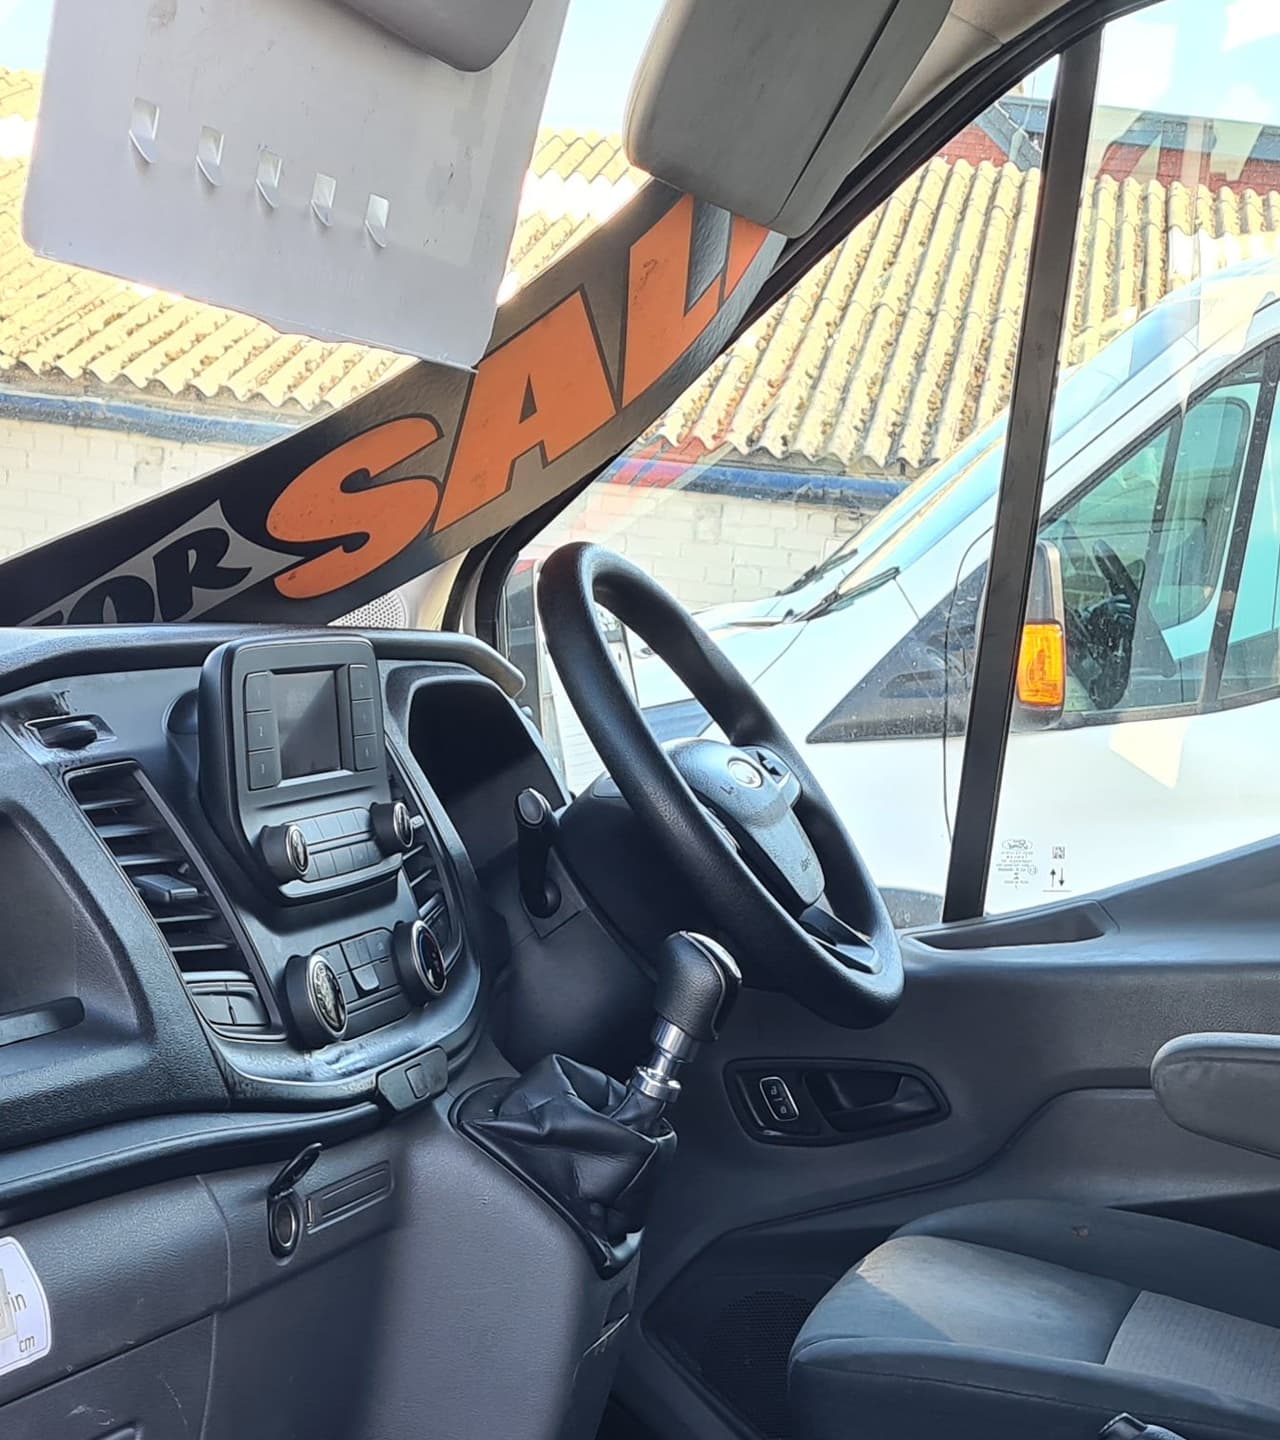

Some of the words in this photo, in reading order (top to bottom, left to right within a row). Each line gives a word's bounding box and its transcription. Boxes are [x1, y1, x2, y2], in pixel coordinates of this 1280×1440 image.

[32, 528, 253, 625] OR
[266, 192, 771, 600] SAL
[7, 1290, 27, 1313] in
[19, 1335, 36, 1353] cm
